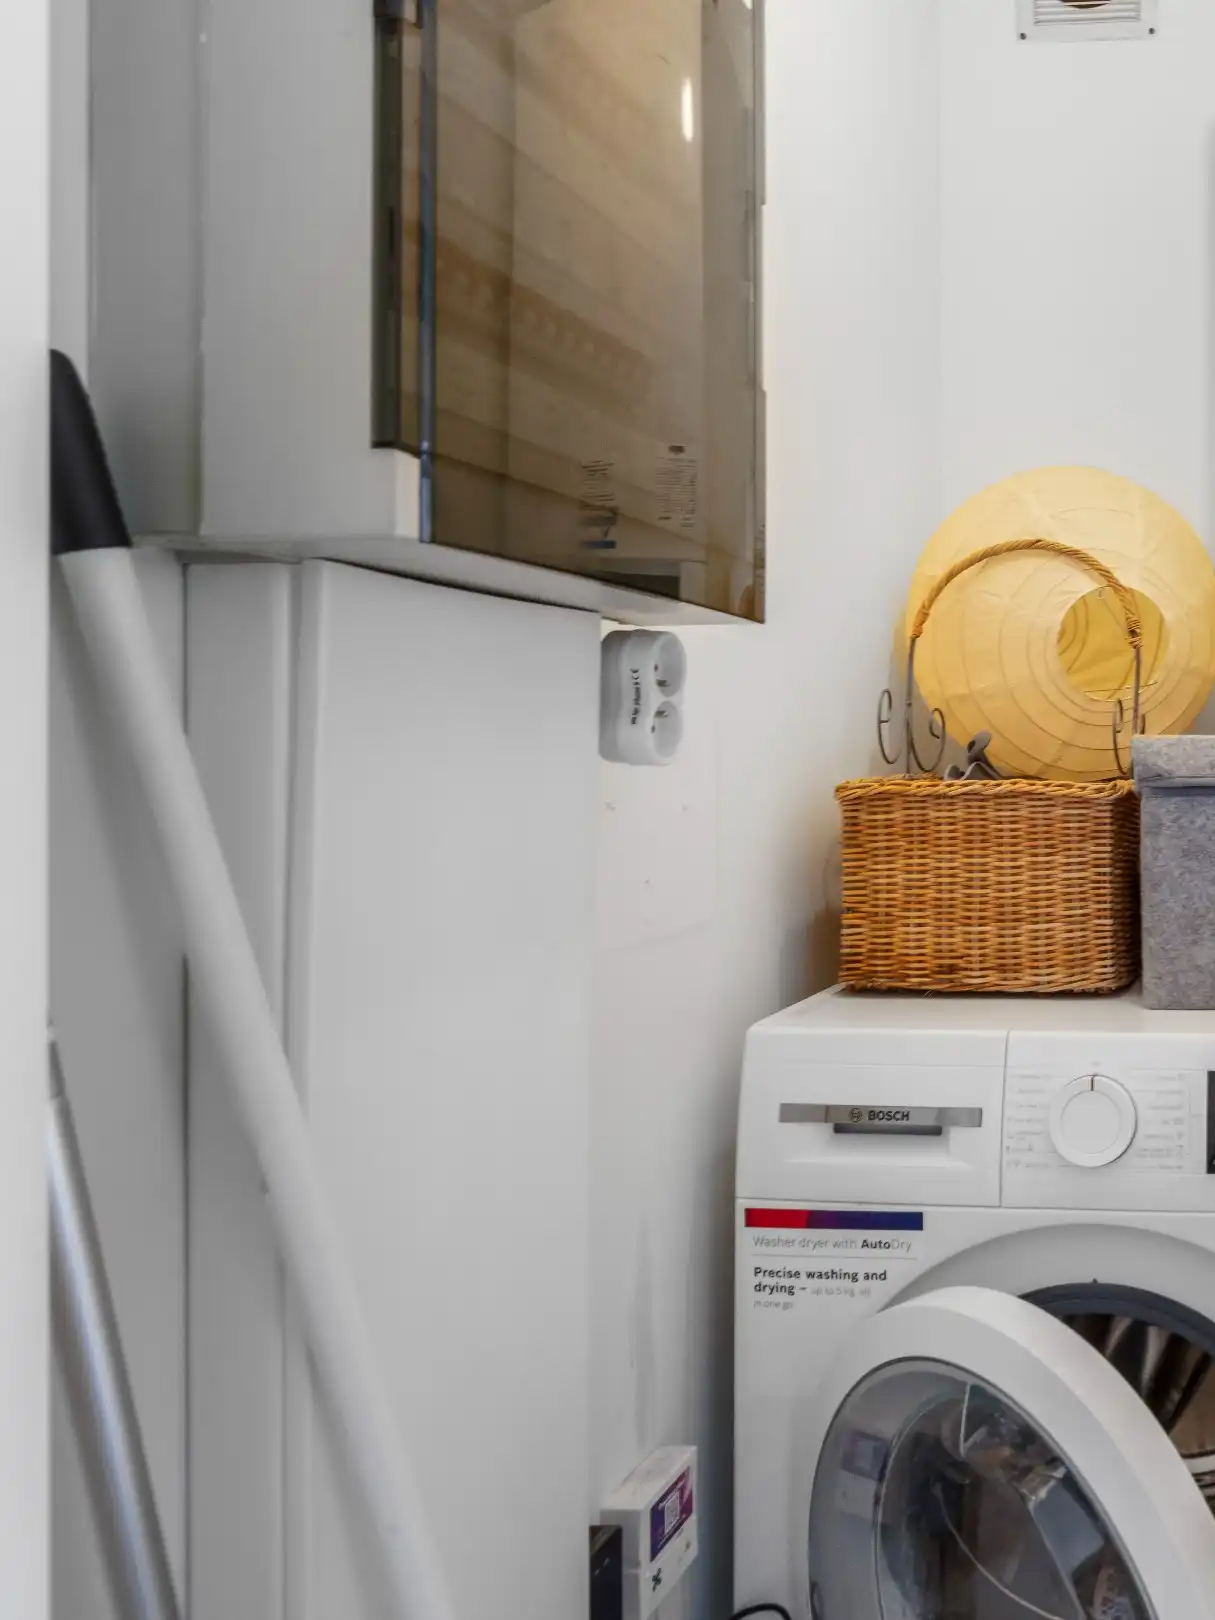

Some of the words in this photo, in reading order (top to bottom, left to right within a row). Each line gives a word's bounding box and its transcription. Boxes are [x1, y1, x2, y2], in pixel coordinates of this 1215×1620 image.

[868, 1109, 910, 1122] BOSCH
[753, 1235, 795, 1248] Washer
[799, 1238, 828, 1251] dryer
[832, 1239, 857, 1249] with
[861, 1239, 912, 1252] AutoDry
[754, 1266, 801, 1279] Precise
[805, 1268, 858, 1283] washing
[863, 1270, 887, 1281] and
[754, 1282, 795, 1295] drying
